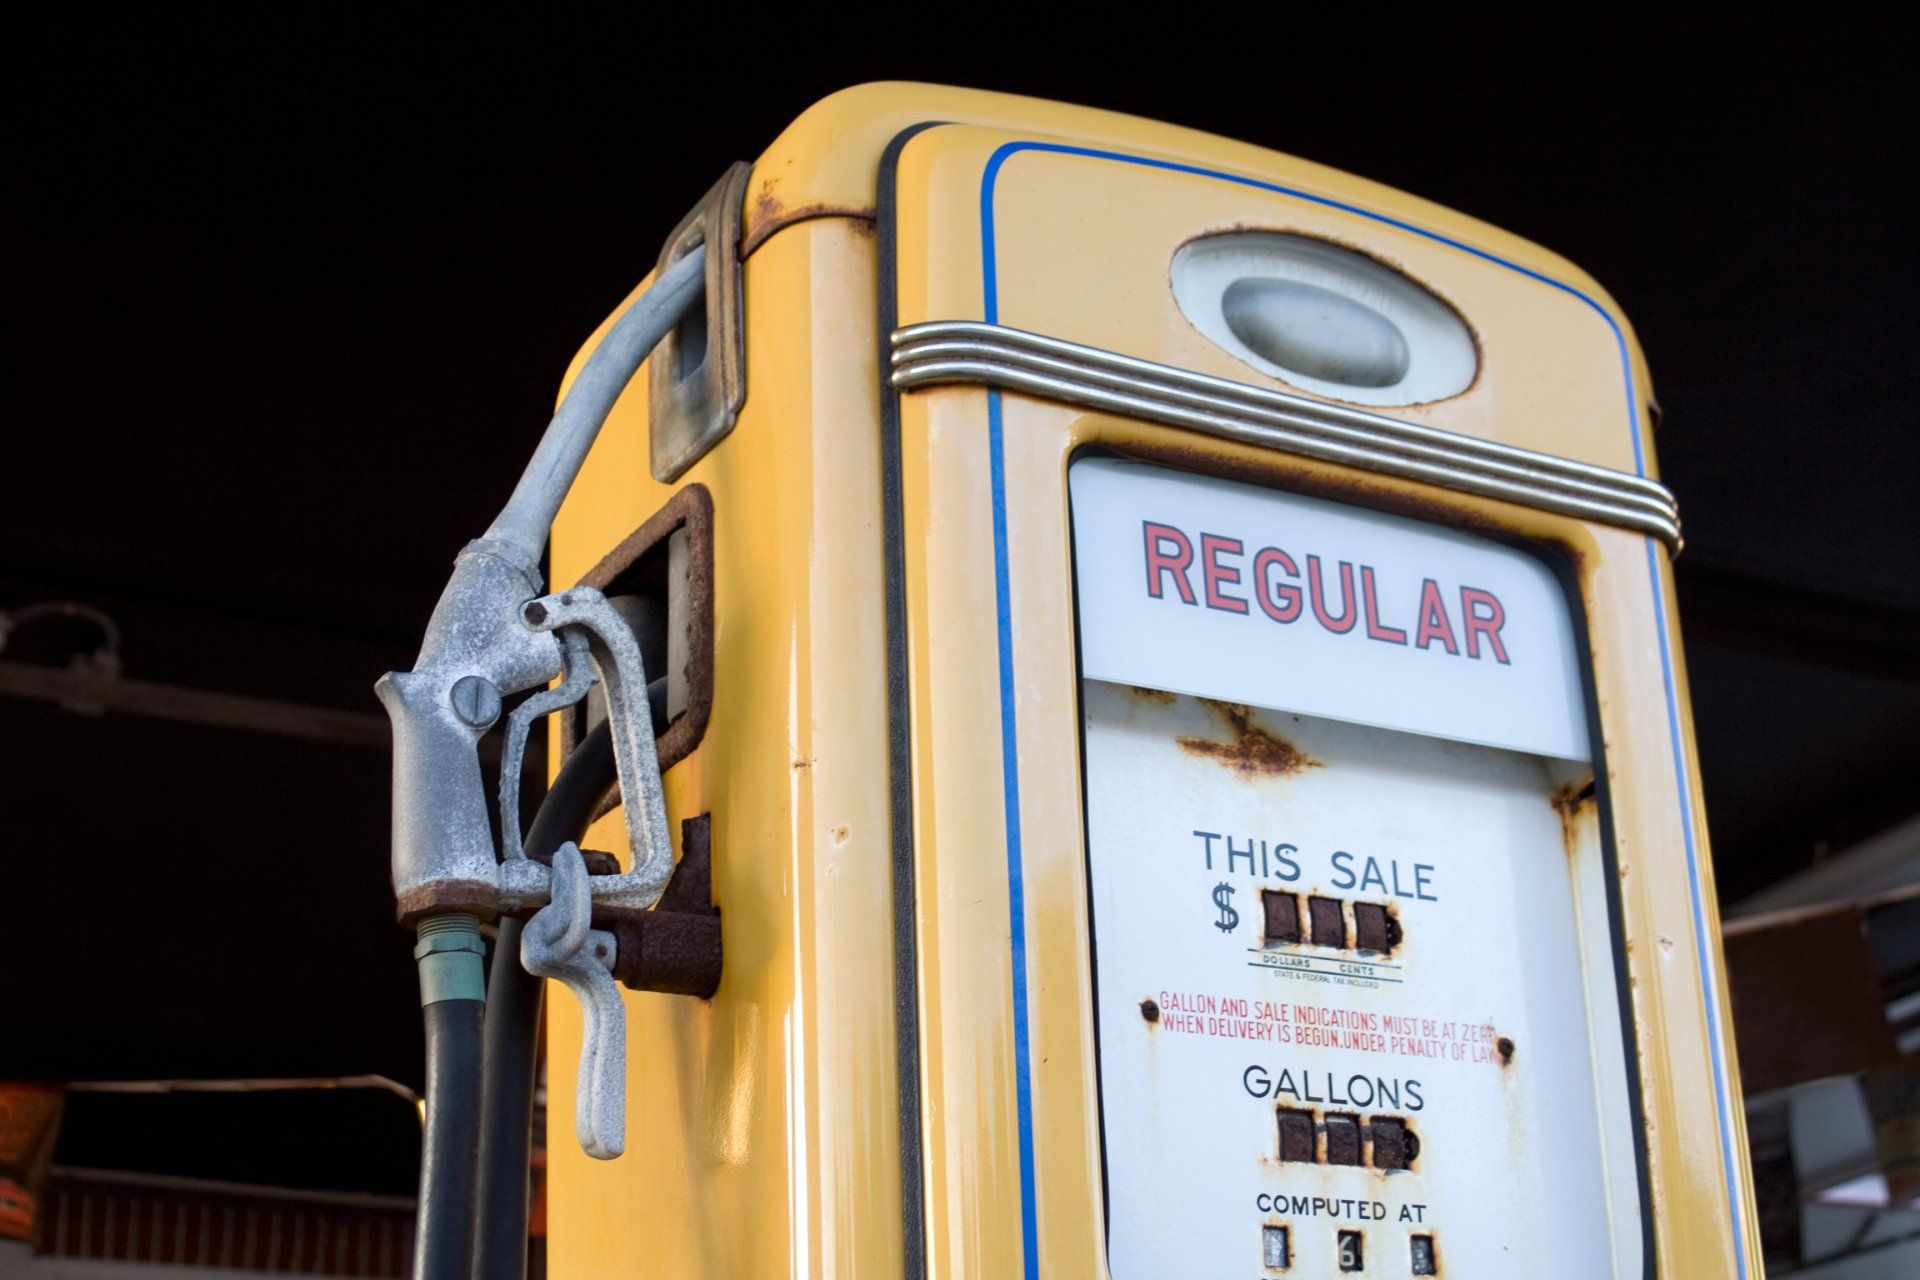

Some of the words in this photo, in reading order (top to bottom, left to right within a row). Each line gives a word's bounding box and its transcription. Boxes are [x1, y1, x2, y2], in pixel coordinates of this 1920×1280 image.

[1142, 520, 1511, 665] REGULAR
[1193, 830, 1301, 882] THIS
[1331, 851, 1438, 902] SALE
[1212, 881, 1240, 934] $
[1264, 955, 1310, 967] DOLLARS
[1340, 964, 1374, 975] CENTS
[1273, 970, 1294, 979] STATE
[1302, 973, 1331, 983] FEDERAL
[1333, 976, 1345, 985] TAX
[1346, 979, 1379, 989] INCLUDED
[1160, 991, 1216, 1014] GALLON
[1220, 997, 1248, 1018] AND
[1254, 1001, 1289, 1022] SALE
[1293, 1004, 1377, 1032] INDICATIONS
[1383, 1016, 1418, 1036] MUST
[1422, 1019, 1439, 1038] BE
[1442, 1022, 1457, 1040] AT
[1161, 1012, 1204, 1034] WHEN
[1208, 1017, 1273, 1041] DELIVERY
[1278, 1024, 1291, 1043] IS
[1391, 1036, 1447, 1059] PENALTY
[1451, 1042, 1466, 1061] OF
[1243, 1065, 1424, 1111] GALLONS
[1256, 1193, 1387, 1221] COMPUTED
[1399, 1204, 1427, 1223] AT
